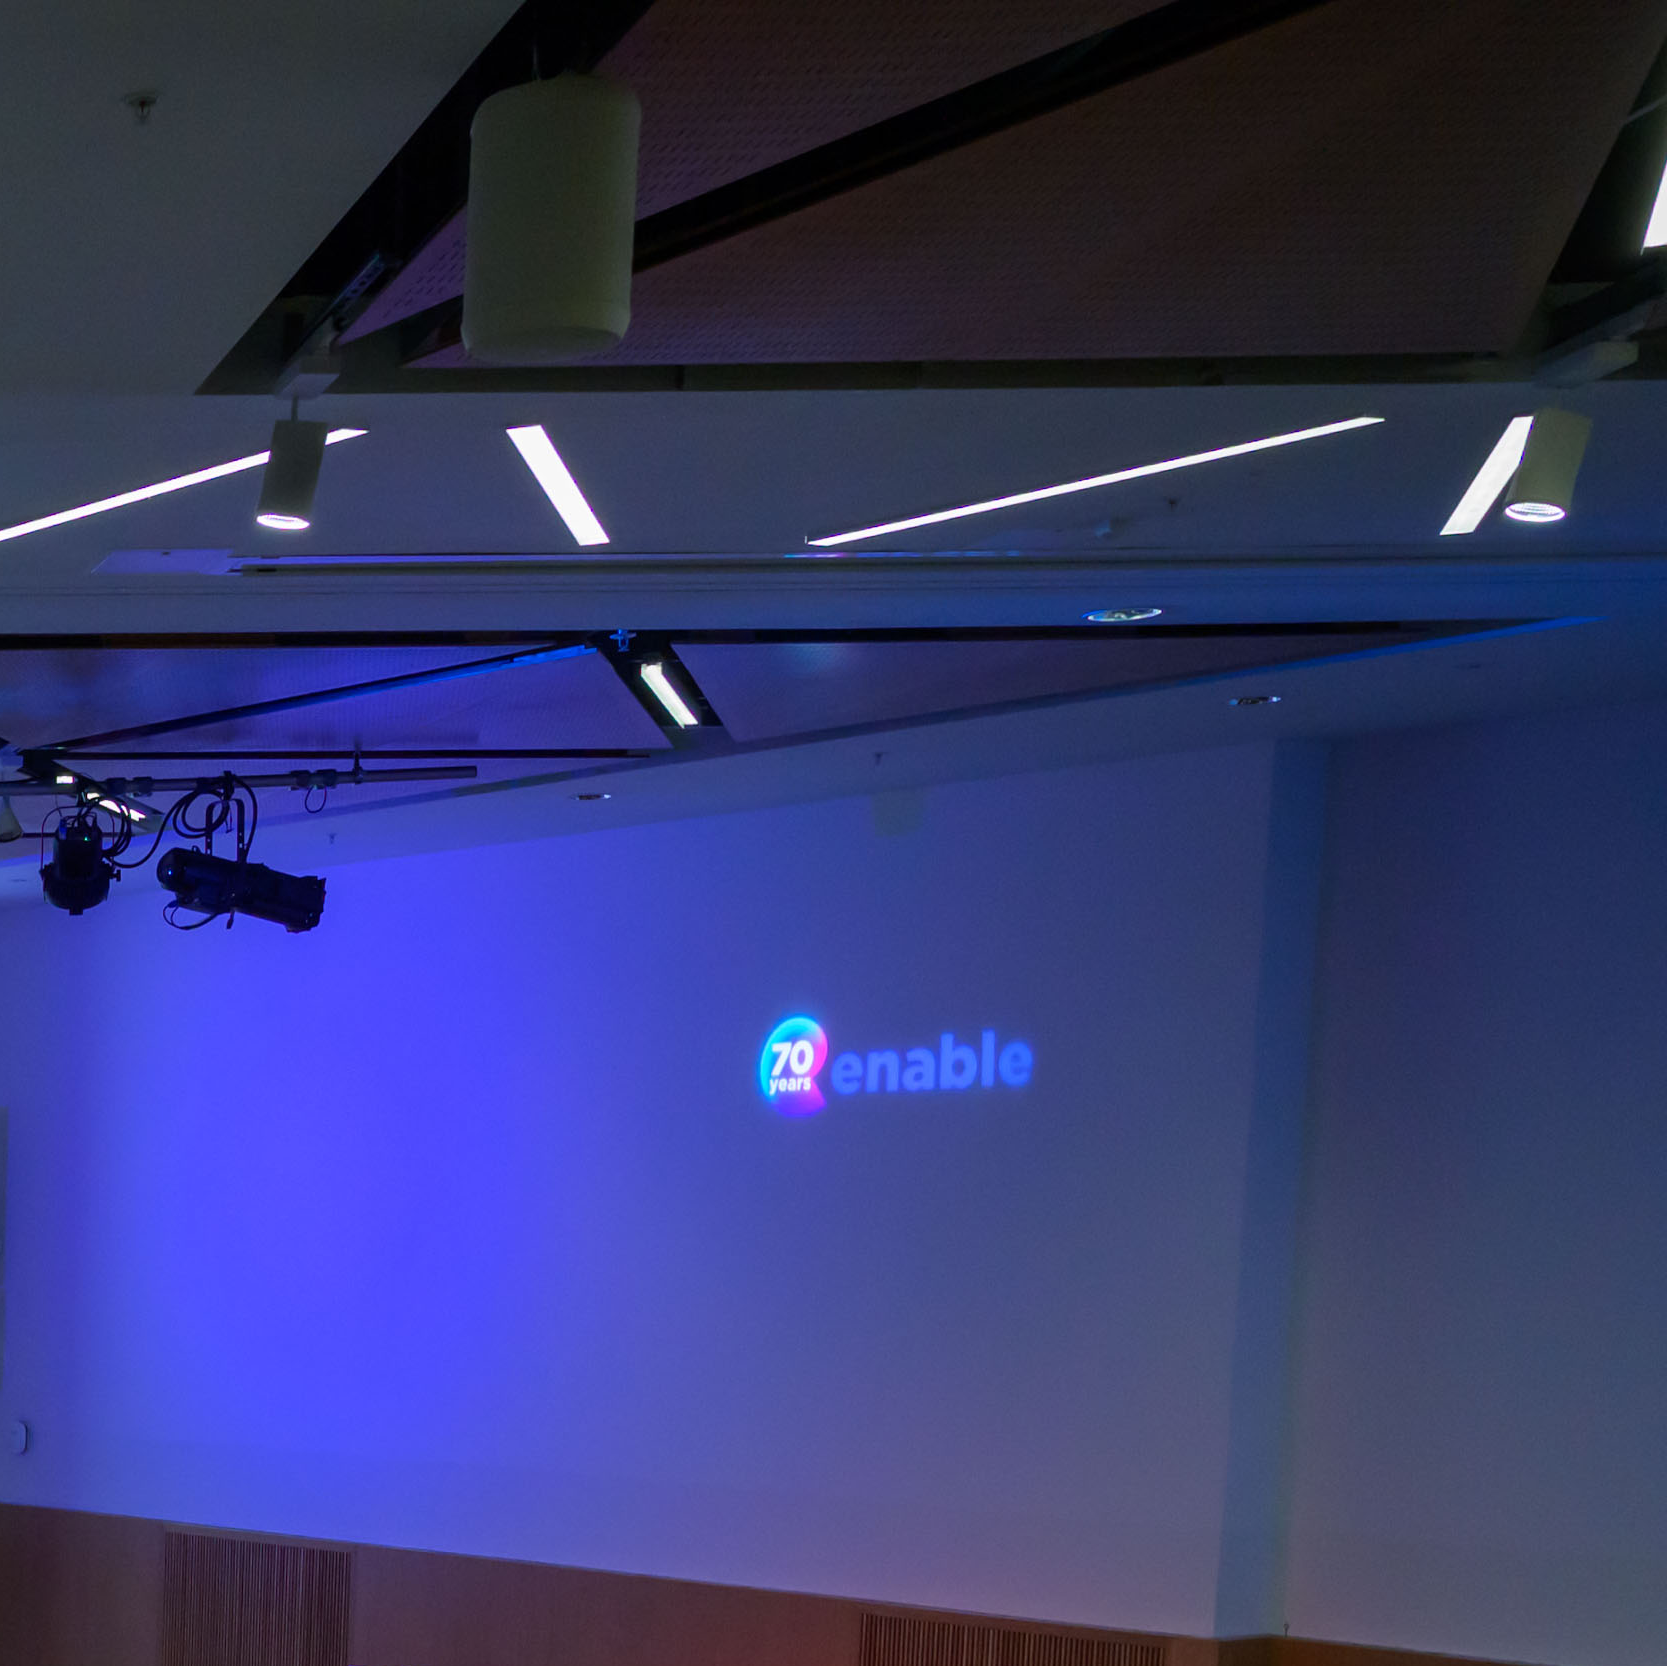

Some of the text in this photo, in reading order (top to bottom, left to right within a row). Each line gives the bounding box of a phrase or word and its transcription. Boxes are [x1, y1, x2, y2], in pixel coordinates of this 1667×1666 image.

[771, 1040, 815, 1076] 70
[830, 1030, 1033, 1095] enable
[769, 1074, 812, 1095] years
